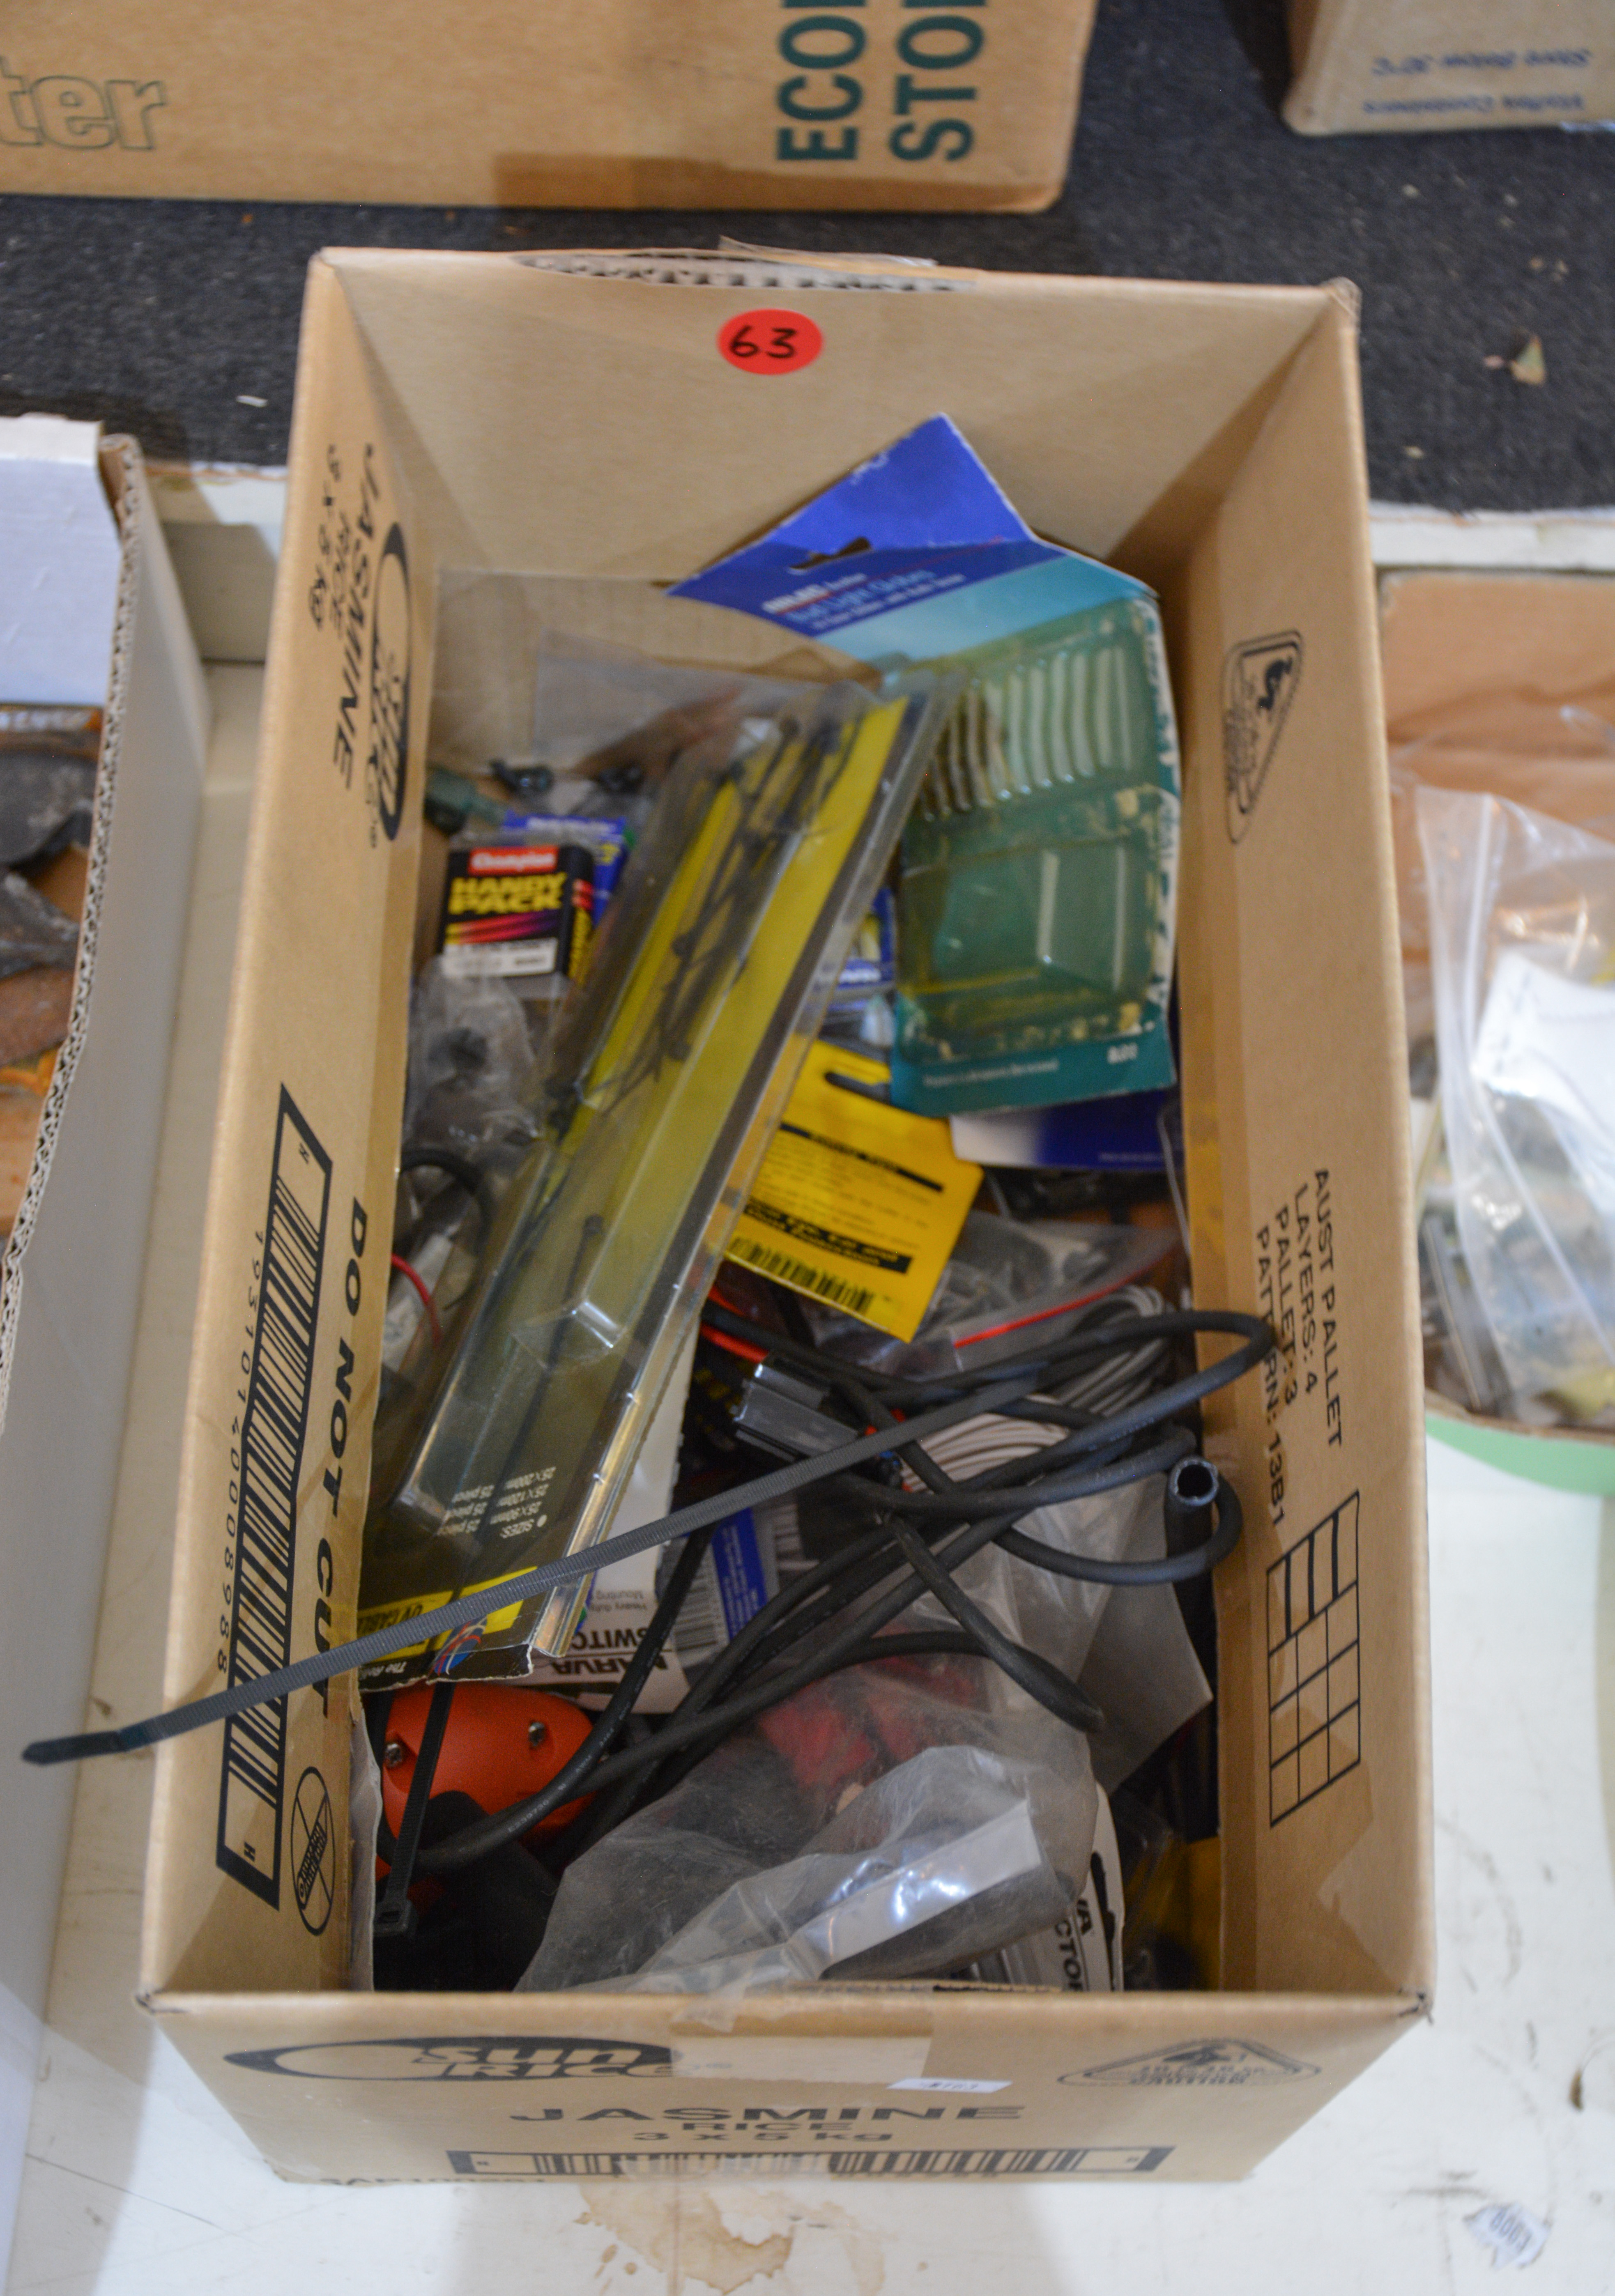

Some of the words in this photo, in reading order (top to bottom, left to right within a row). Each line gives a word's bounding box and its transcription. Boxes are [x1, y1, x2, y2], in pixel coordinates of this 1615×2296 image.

[775, 0, 869, 161] ECO
[888, 0, 987, 162] STO
[728, 324, 797, 359] 63
[334, 444, 380, 791] JASMINE
[346, 1197, 368, 1317] DO
[1276, 1205, 1297, 1376] PALLET:
[1295, 1181, 1315, 1362] LAYERS:
[1305, 1371, 1318, 1395] 4
[1315, 1169, 1334, 1272] AUST
[323, 1338, 354, 1518] NOT
[1256, 1224, 1278, 1426] PATTRN:
[1269, 1430, 1285, 1528] 13B1
[1285, 1379, 1298, 1406] 3
[1321, 1284, 1342, 1446] PALLET
[218, 1228, 264, 1675] 19310140008988
[552, 1655, 668, 1675] RVA
[510, 2105, 1026, 2121] JASMINE
[634, 2132, 670, 2141] 3
[754, 2133, 790, 2141] 5
[815, 2132, 894, 2142] kg
[682, 2122, 854, 2131] RICE
